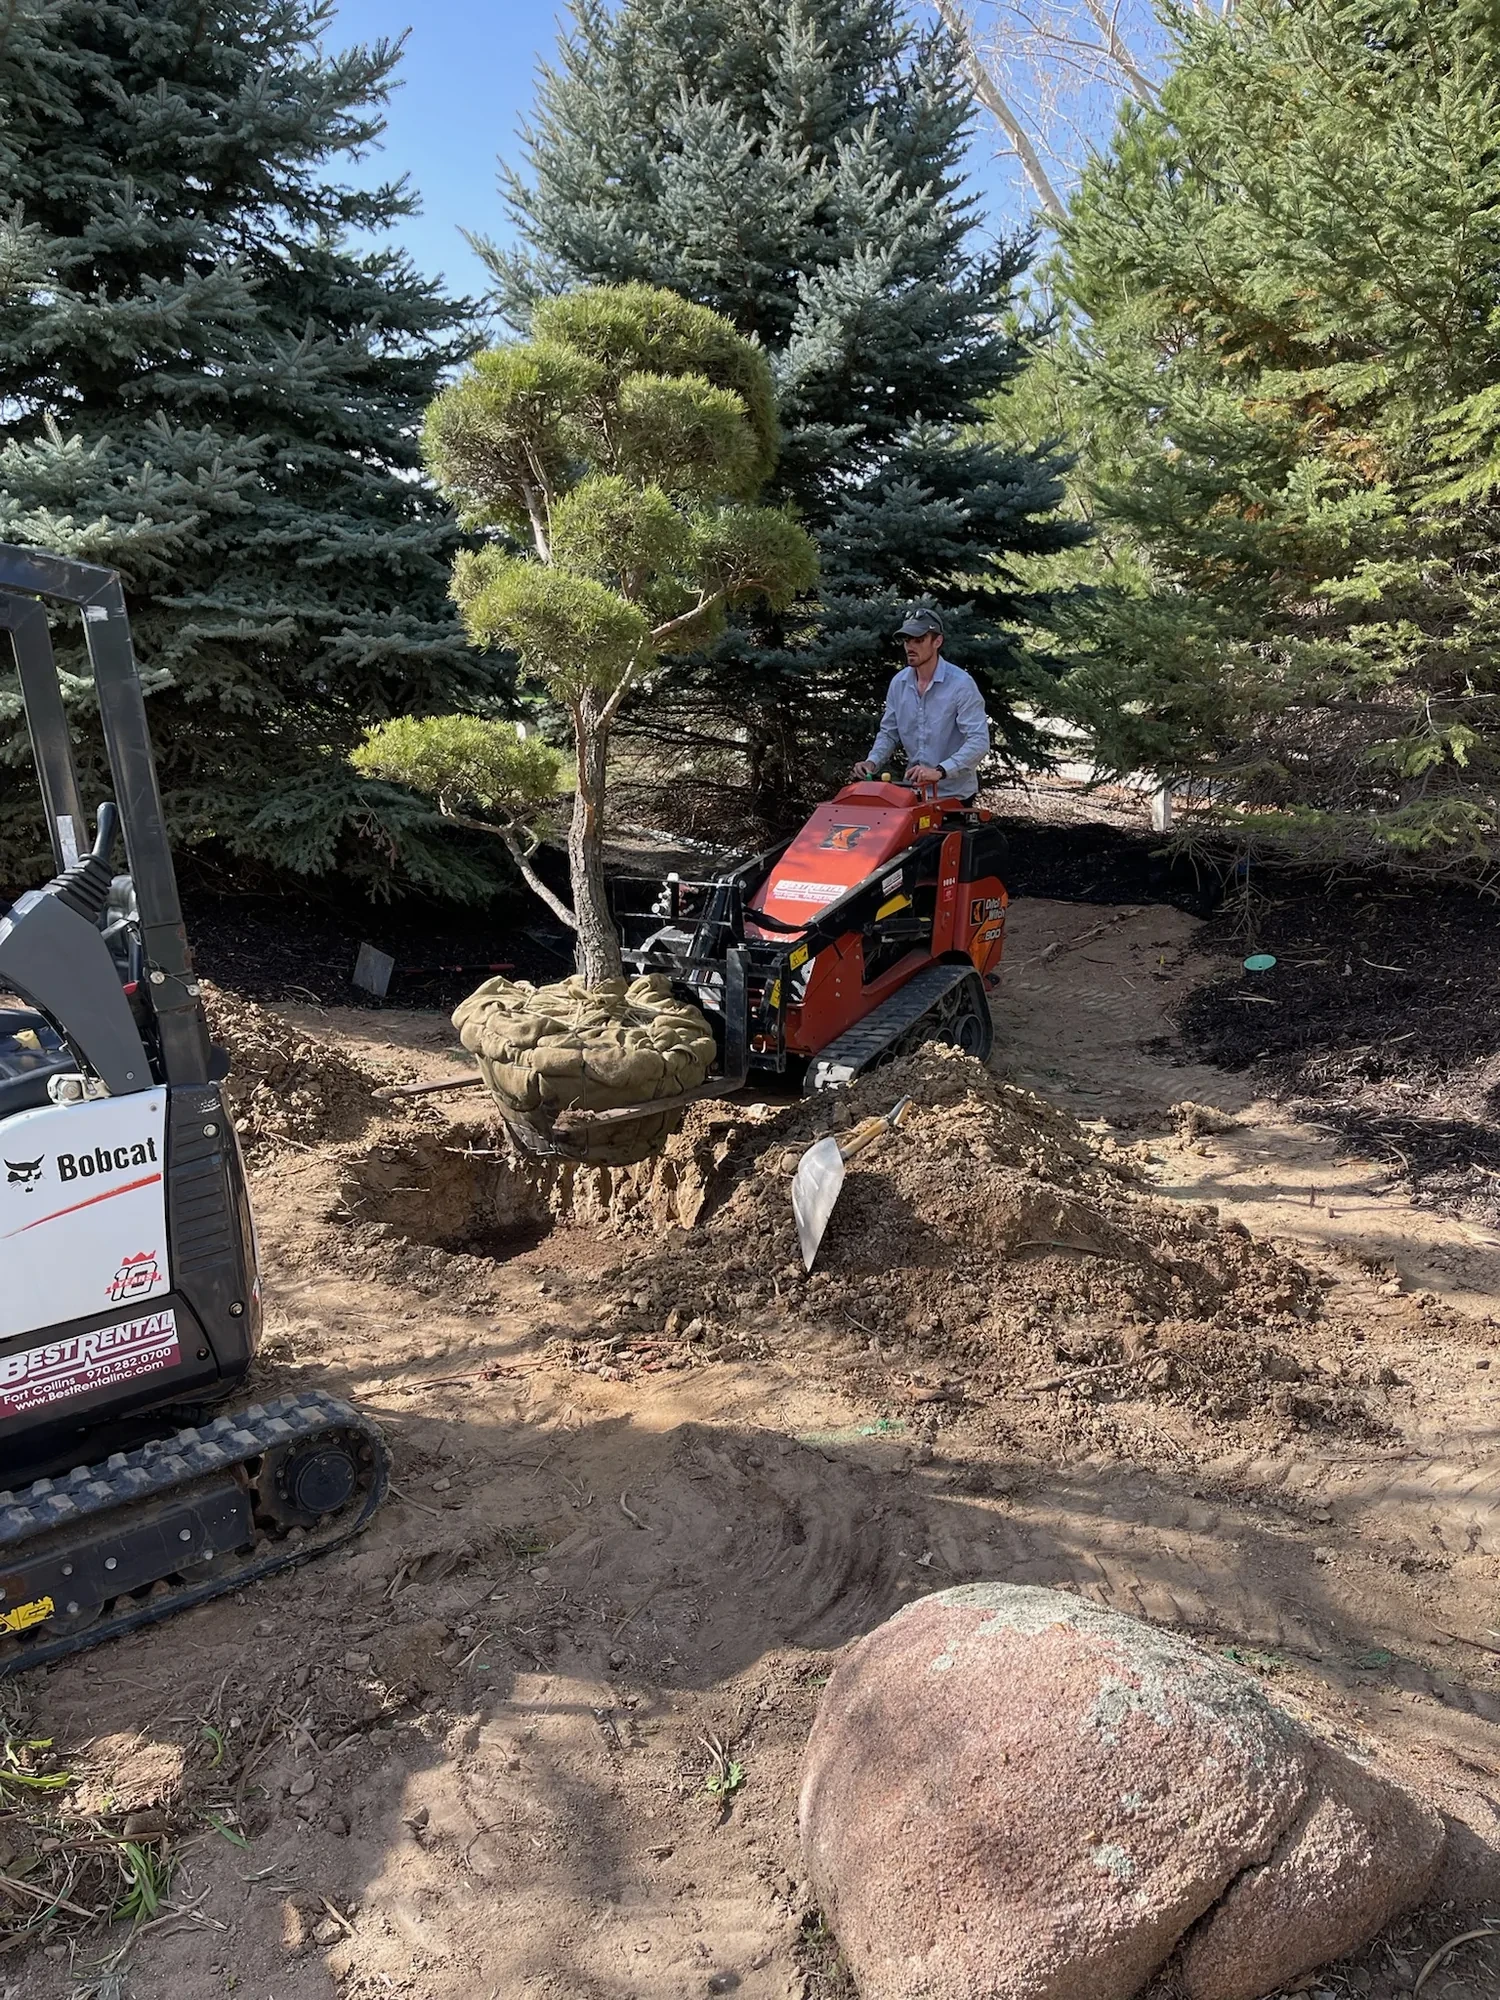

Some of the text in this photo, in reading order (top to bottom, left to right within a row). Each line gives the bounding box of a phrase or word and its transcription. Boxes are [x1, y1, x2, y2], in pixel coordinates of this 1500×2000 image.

[57, 1137, 157, 1182] Bobcat
[111, 1261, 157, 1301] 10
[3, 1347, 171, 1405] Fort Collins 970.282.0700
